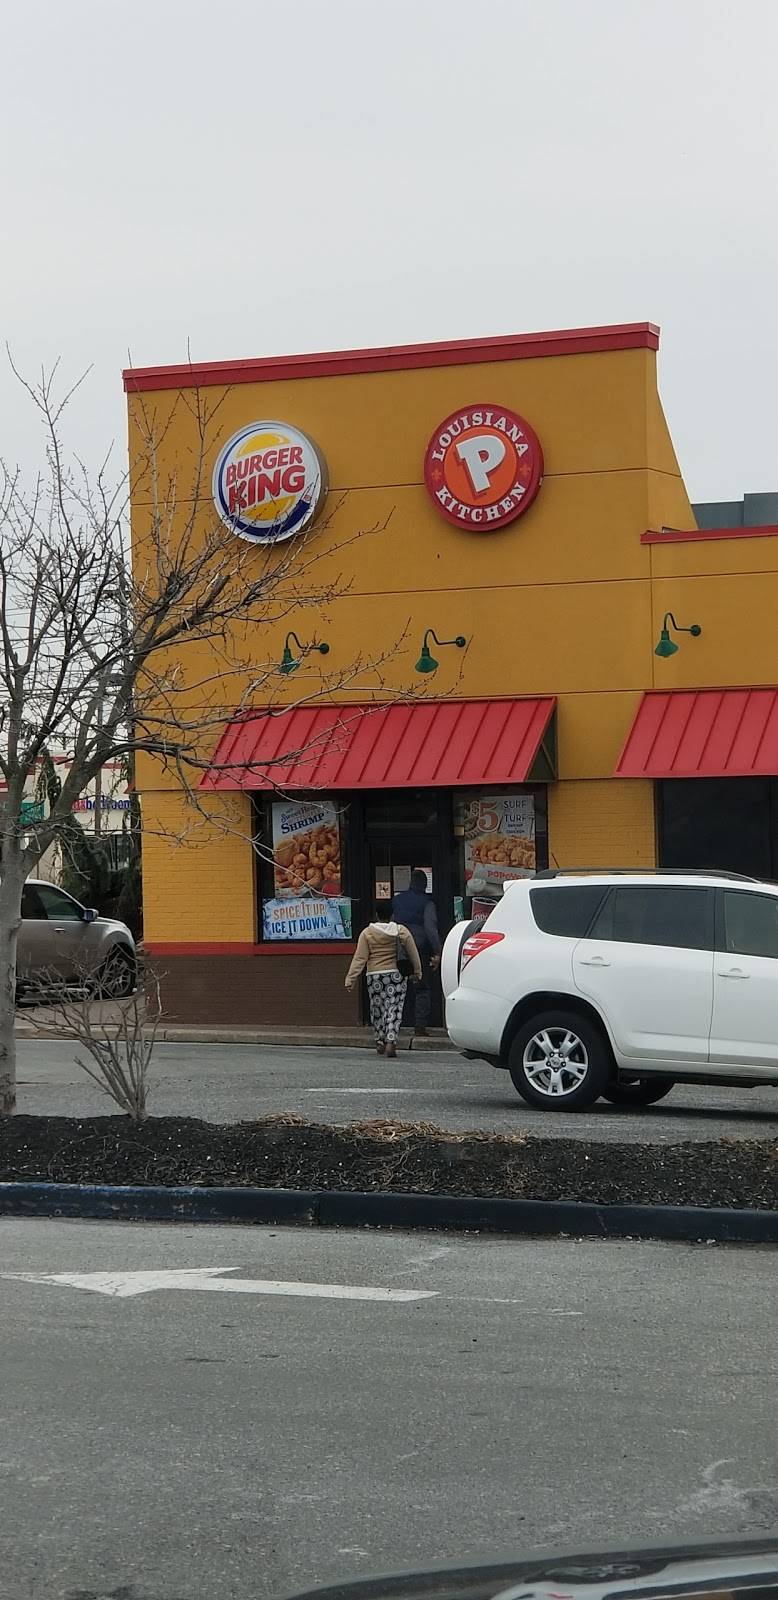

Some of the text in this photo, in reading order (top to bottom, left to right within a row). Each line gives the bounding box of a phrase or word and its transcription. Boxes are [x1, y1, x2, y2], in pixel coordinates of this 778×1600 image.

[432, 411, 529, 462] LOUISIANA
[226, 446, 303, 487] BURGER
[456, 435, 506, 492] P
[228, 465, 306, 514] KING
[436, 482, 526, 521] KITCHEN
[281, 813, 325, 834] SHRIMP
[504, 814, 526, 822] TURF
[272, 921, 287, 934] ICE
[288, 920, 297, 936] IT
[273, 904, 300, 920] SPICE
[301, 901, 311, 917] IT
